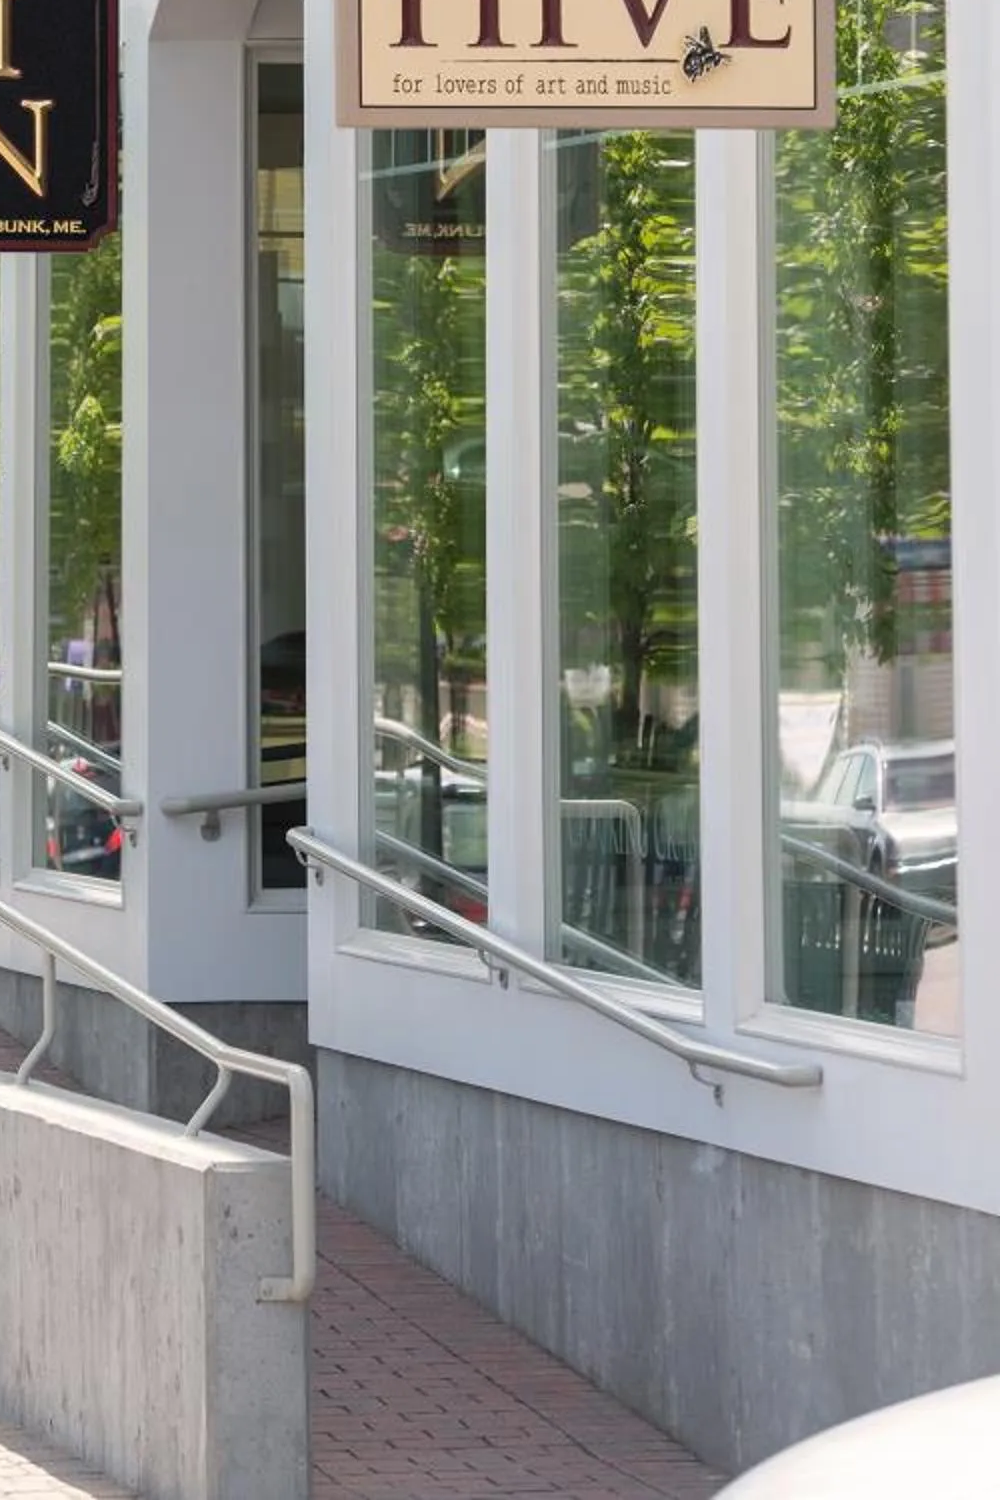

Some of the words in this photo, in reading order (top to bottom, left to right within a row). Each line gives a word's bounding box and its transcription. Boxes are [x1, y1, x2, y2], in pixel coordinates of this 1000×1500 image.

[392, 73, 424, 94] for
[434, 74, 498, 95] lovers
[504, 74, 525, 95] of
[535, 76, 567, 95] art
[575, 74, 609, 95] and
[616, 74, 673, 96] music
[53, 219, 87, 234] ME.
